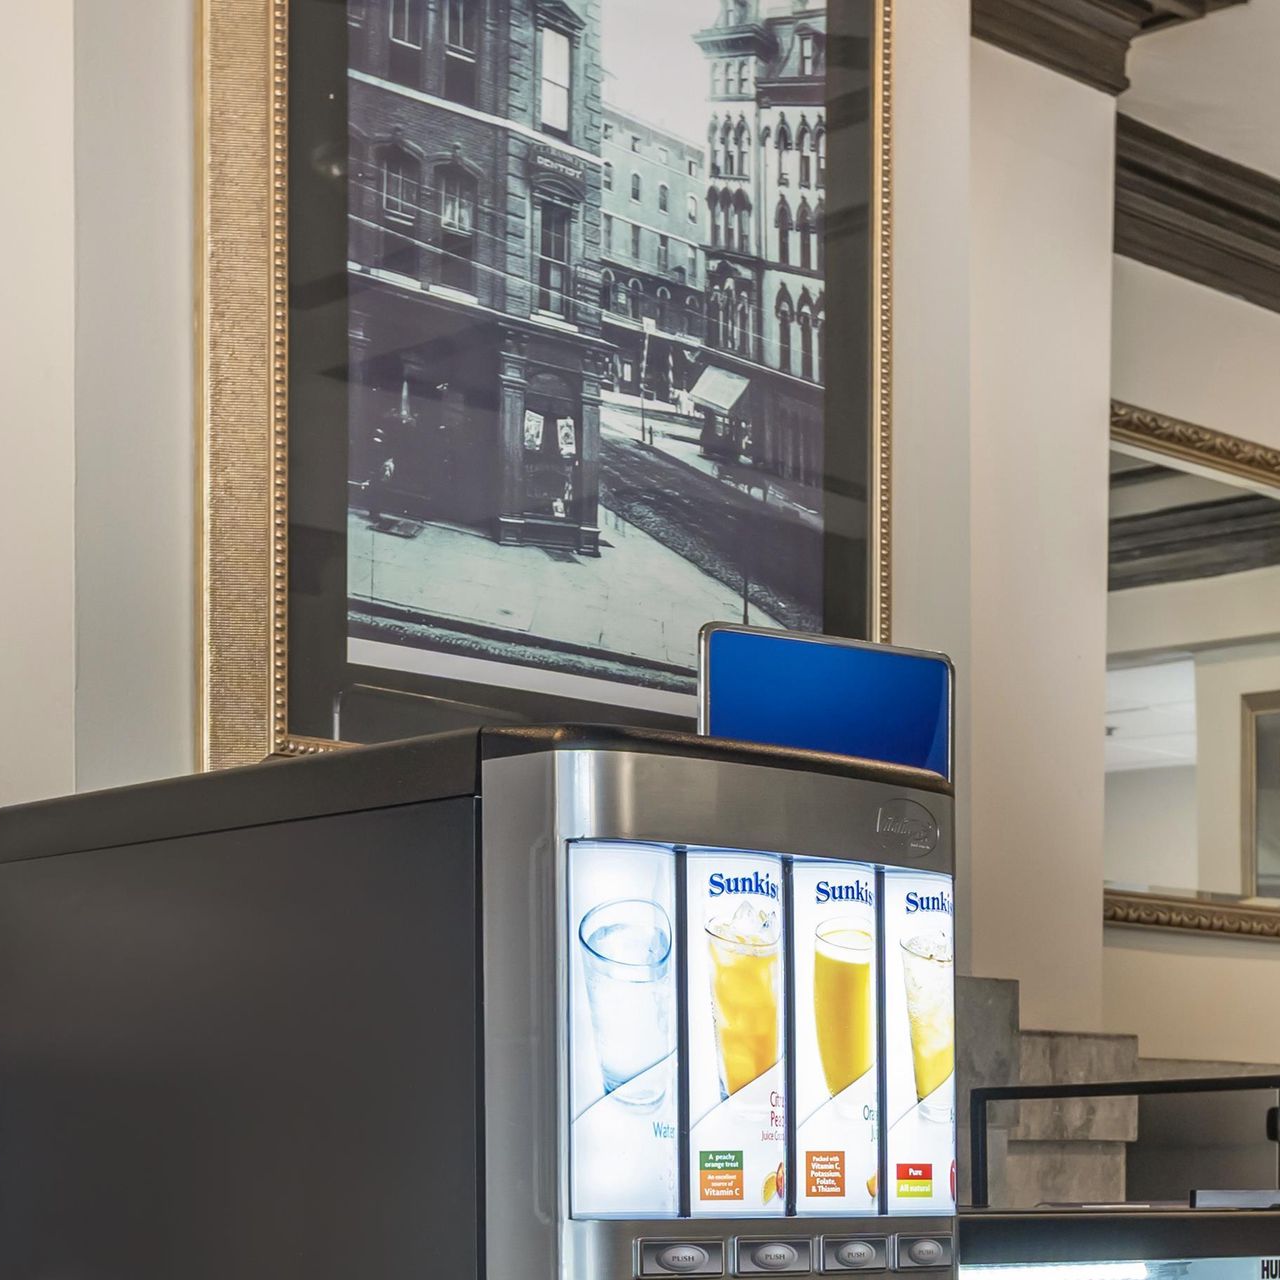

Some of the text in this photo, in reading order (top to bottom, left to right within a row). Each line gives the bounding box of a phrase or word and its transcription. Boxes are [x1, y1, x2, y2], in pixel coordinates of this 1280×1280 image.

[815, 880, 874, 905] Sunkis
[905, 891, 953, 915] Sunkis
[715, 1153, 735, 1162] peachy
[704, 1188, 740, 1196] Vitamin C
[671, 1254, 695, 1263] PUSH
[764, 1252, 786, 1261] PUSH
[846, 1251, 866, 1259] PUSH
